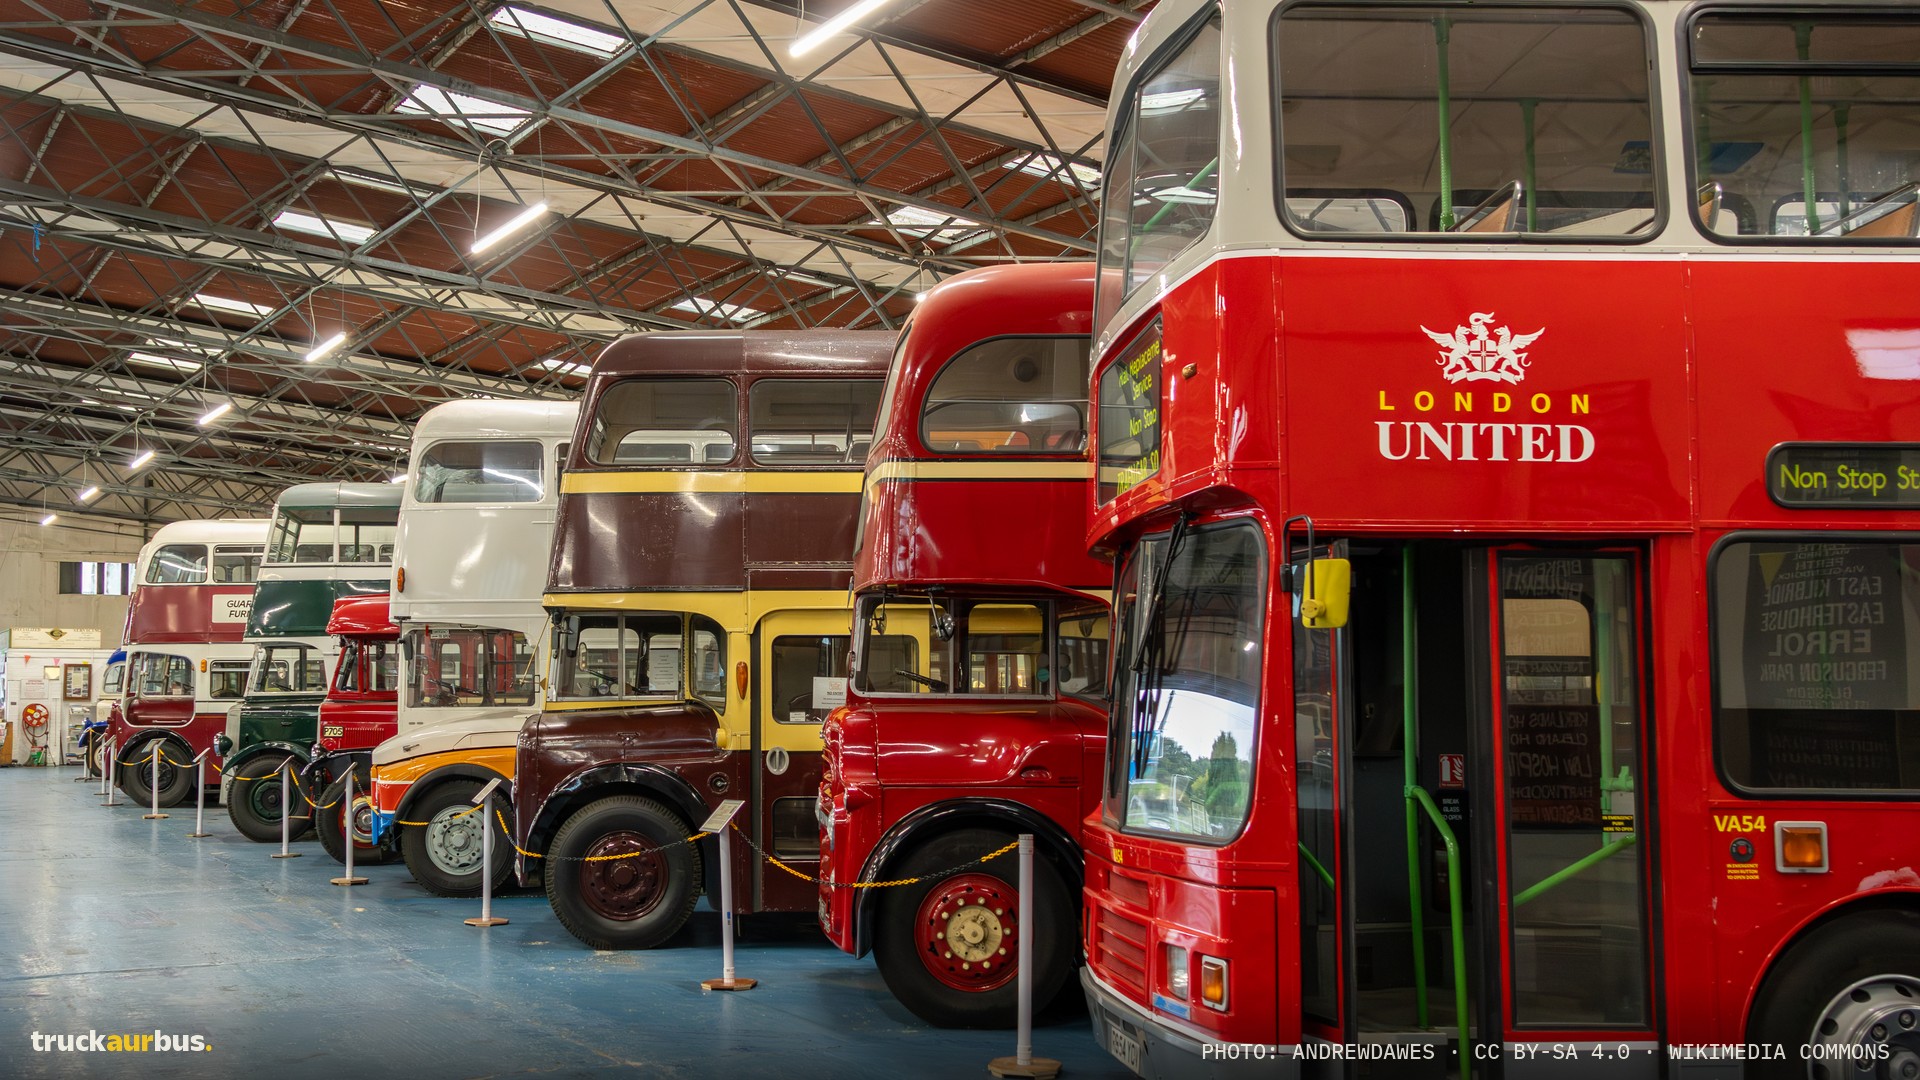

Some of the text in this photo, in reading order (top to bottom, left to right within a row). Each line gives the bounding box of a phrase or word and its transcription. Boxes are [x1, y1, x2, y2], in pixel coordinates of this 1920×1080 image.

[1133, 374, 1153, 401] Service
[1379, 390, 1590, 414] LONDON
[1130, 417, 1142, 438] Non
[1374, 421, 1596, 463] UNITED
[1781, 464, 1827, 489] Non
[1837, 464, 1887, 496] Stop
[1897, 465, 1920, 489] St
[1713, 815, 1767, 833] VA54
